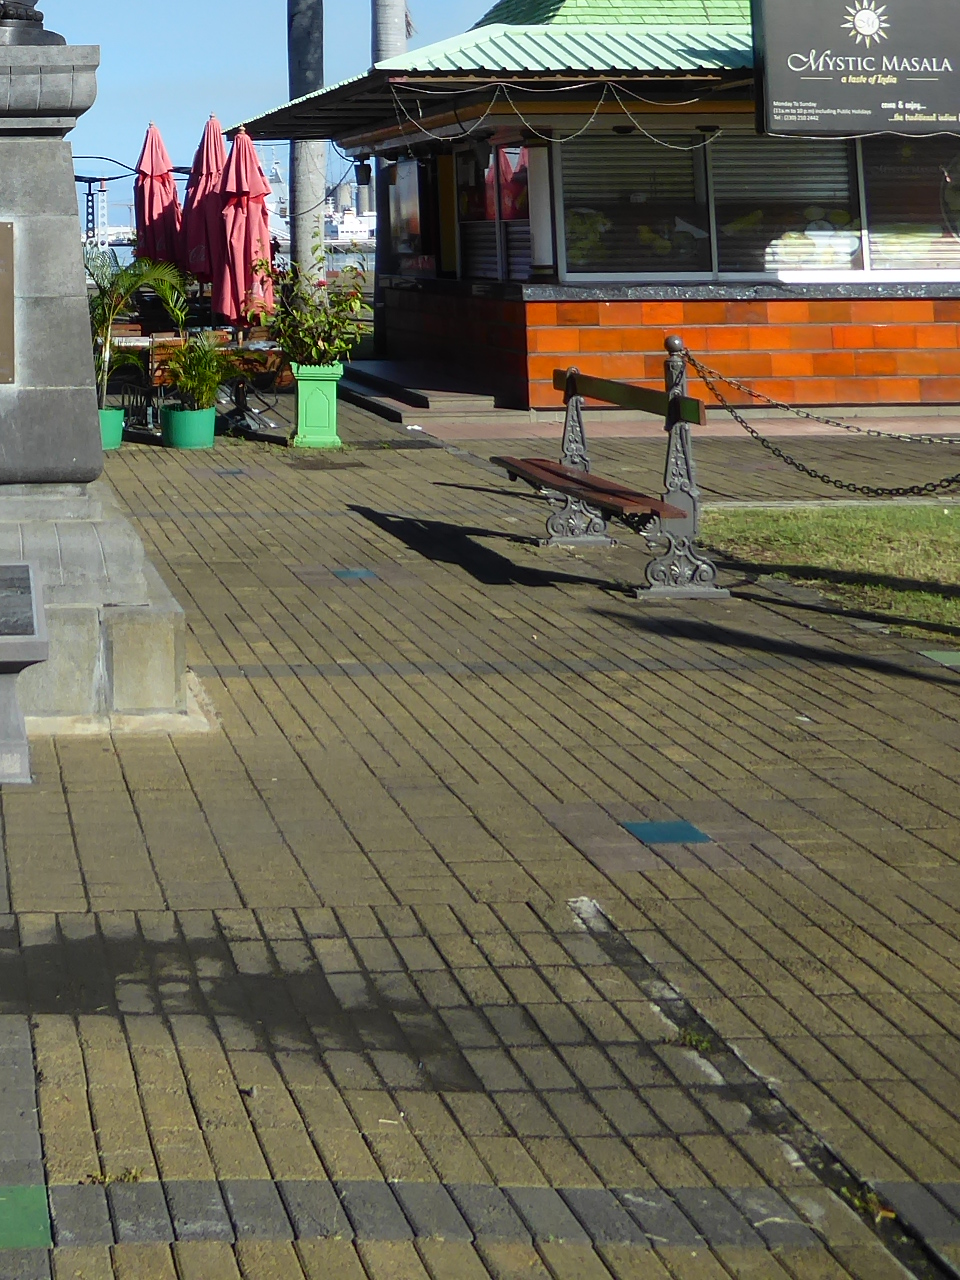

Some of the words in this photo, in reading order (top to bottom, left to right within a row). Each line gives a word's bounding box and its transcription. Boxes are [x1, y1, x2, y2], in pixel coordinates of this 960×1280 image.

[787, 49, 875, 72] MYSTIC
[881, 55, 953, 72] MASALA
[848, 74, 867, 84] taste
[868, 74, 878, 85] of
[877, 74, 897, 86] India
[897, 100, 904, 109] &
[905, 113, 937, 121] traditional
